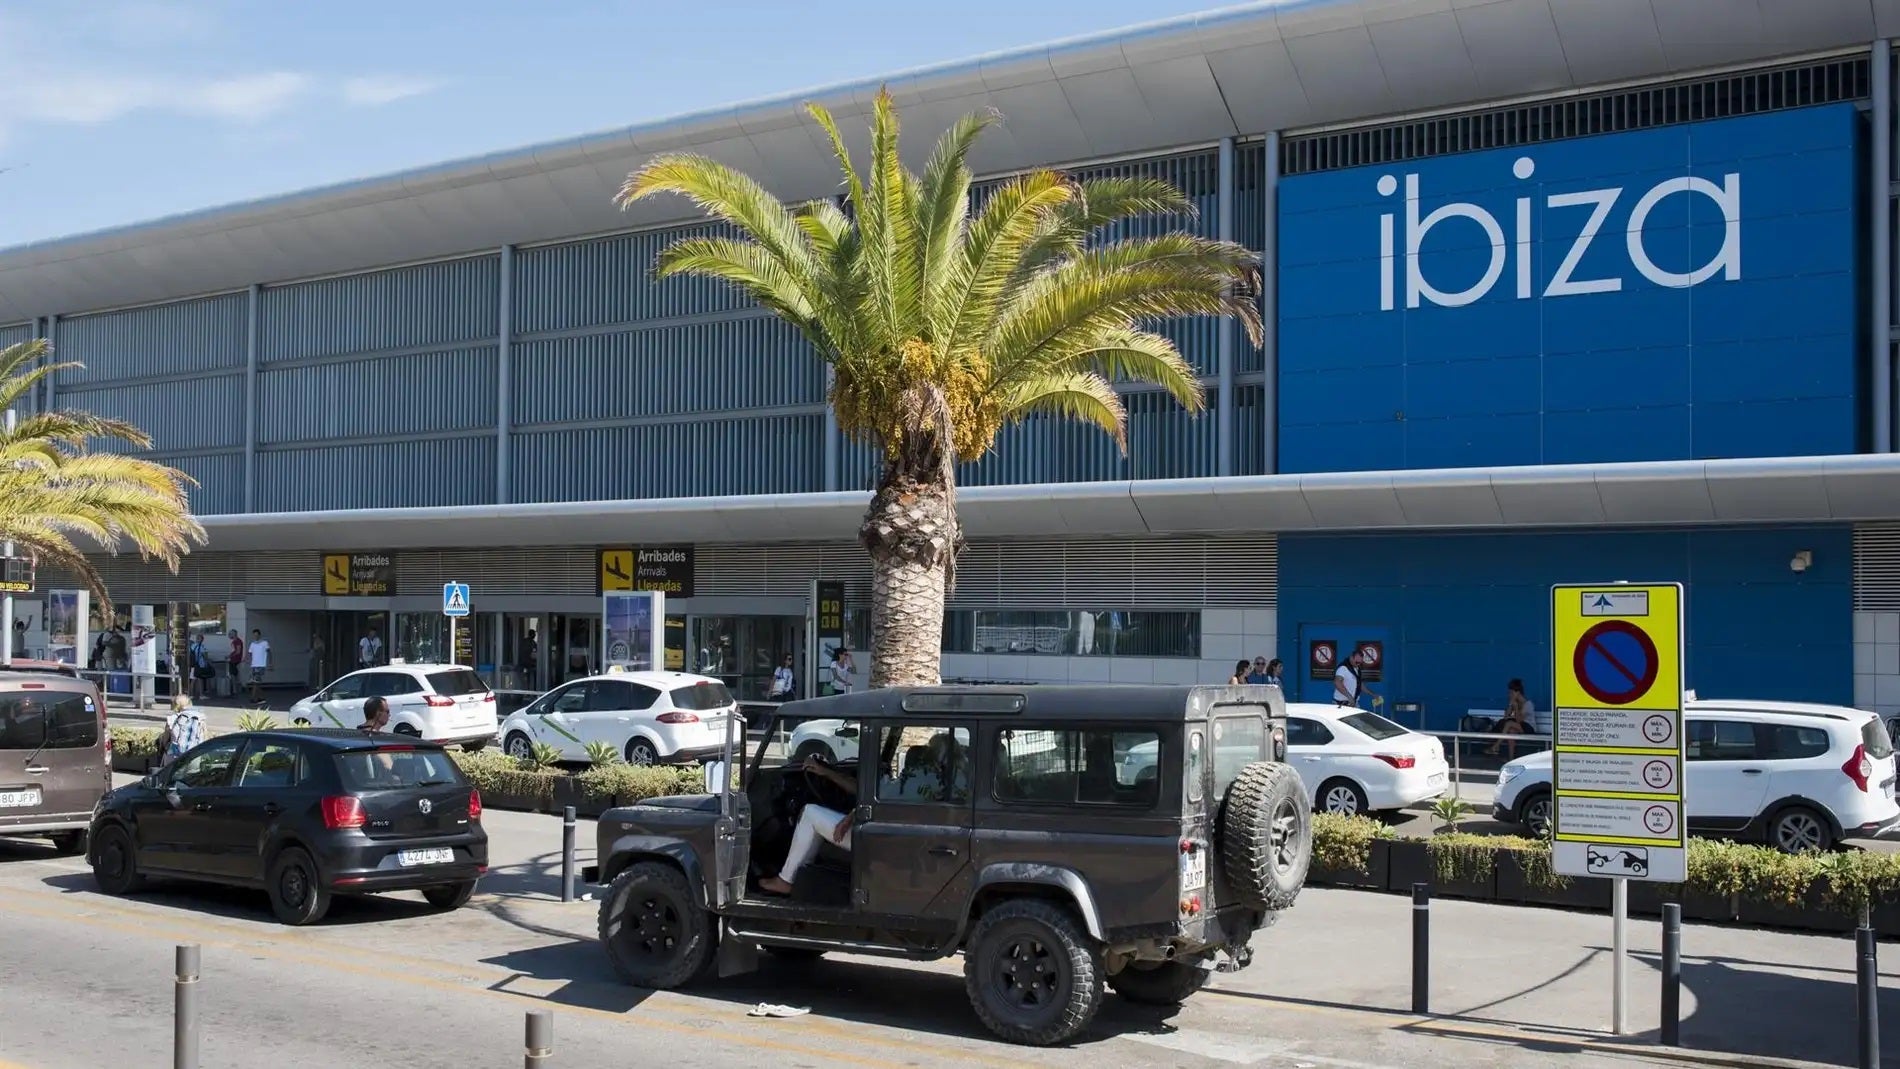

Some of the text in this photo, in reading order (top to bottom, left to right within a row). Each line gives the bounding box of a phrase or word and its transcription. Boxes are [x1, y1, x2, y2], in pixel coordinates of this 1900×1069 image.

[1376, 156, 1740, 311] ibiza
[352, 555, 390, 566] Arribades
[638, 550, 686, 562] Arribades
[638, 566, 667, 577] Arrivals
[638, 580, 682, 591] Llegadas
[0, 792, 36, 804] 80 JFP
